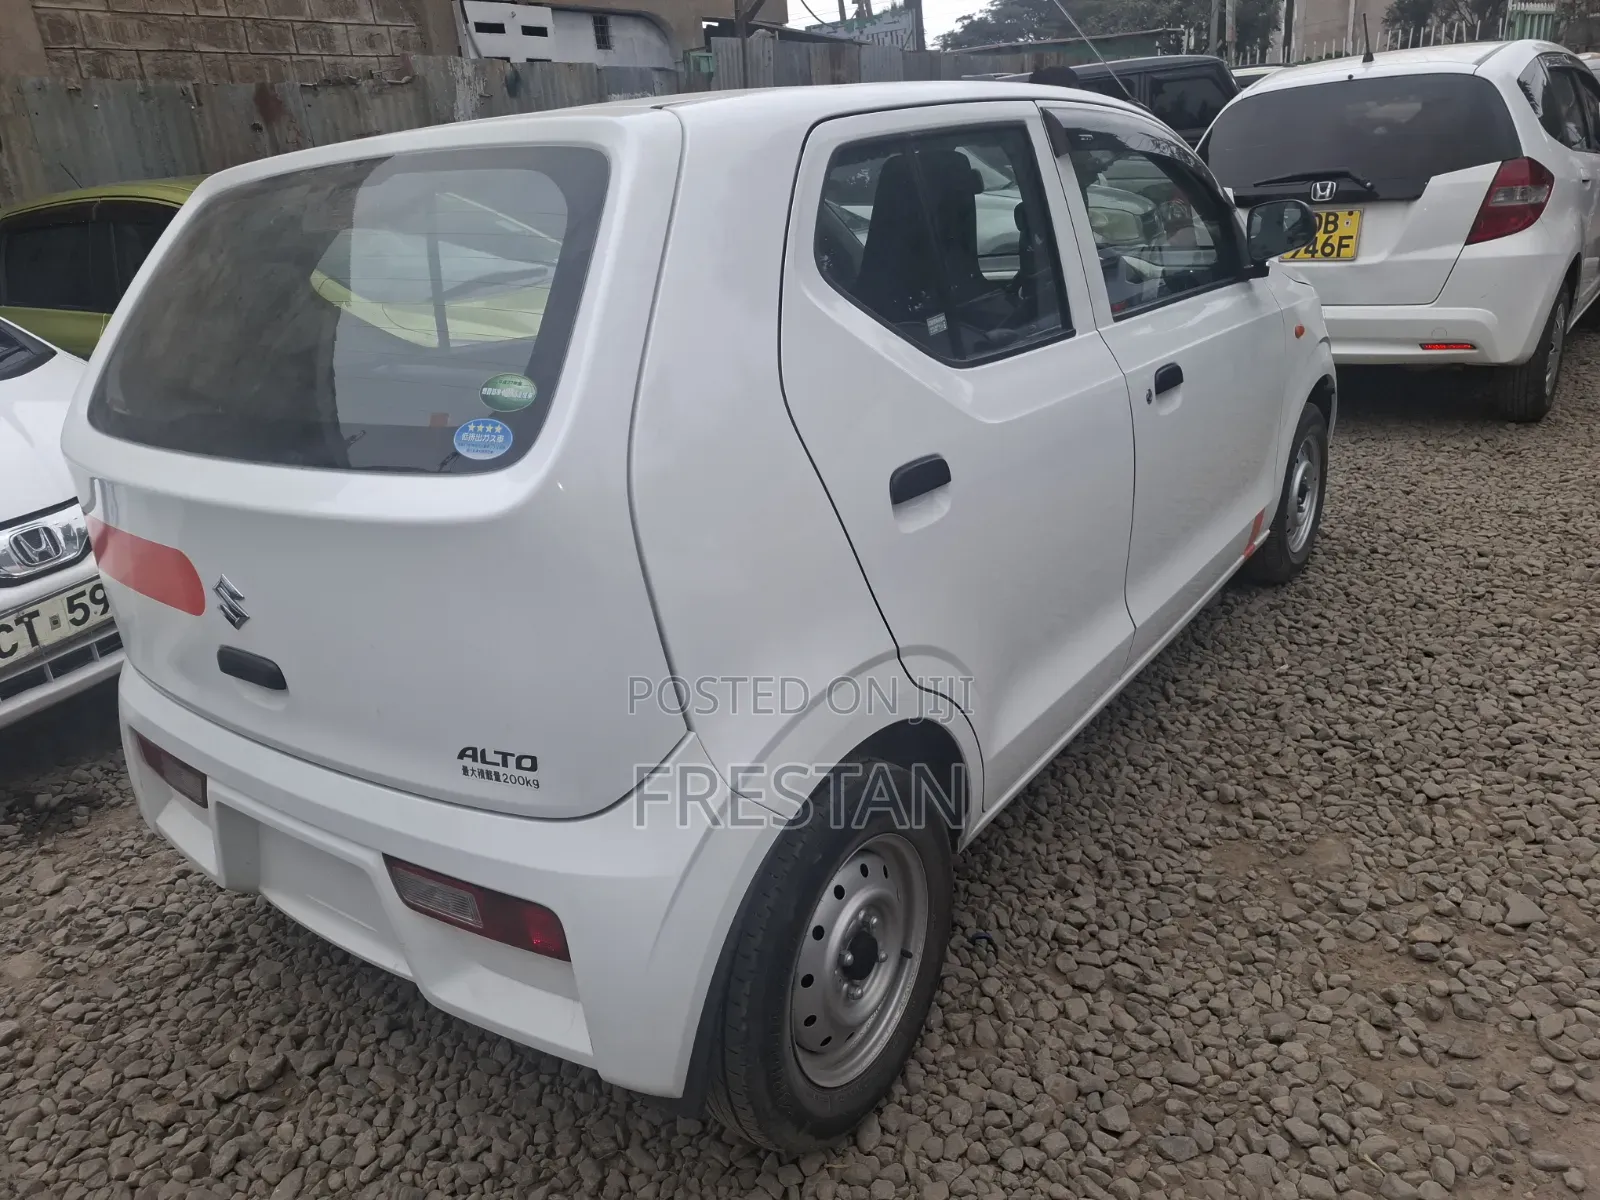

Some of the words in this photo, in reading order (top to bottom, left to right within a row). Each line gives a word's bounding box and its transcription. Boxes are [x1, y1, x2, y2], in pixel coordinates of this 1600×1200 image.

[1290, 235, 1354, 258] 46F
[66, 583, 110, 627] 59
[456, 746, 539, 773] ALTO
